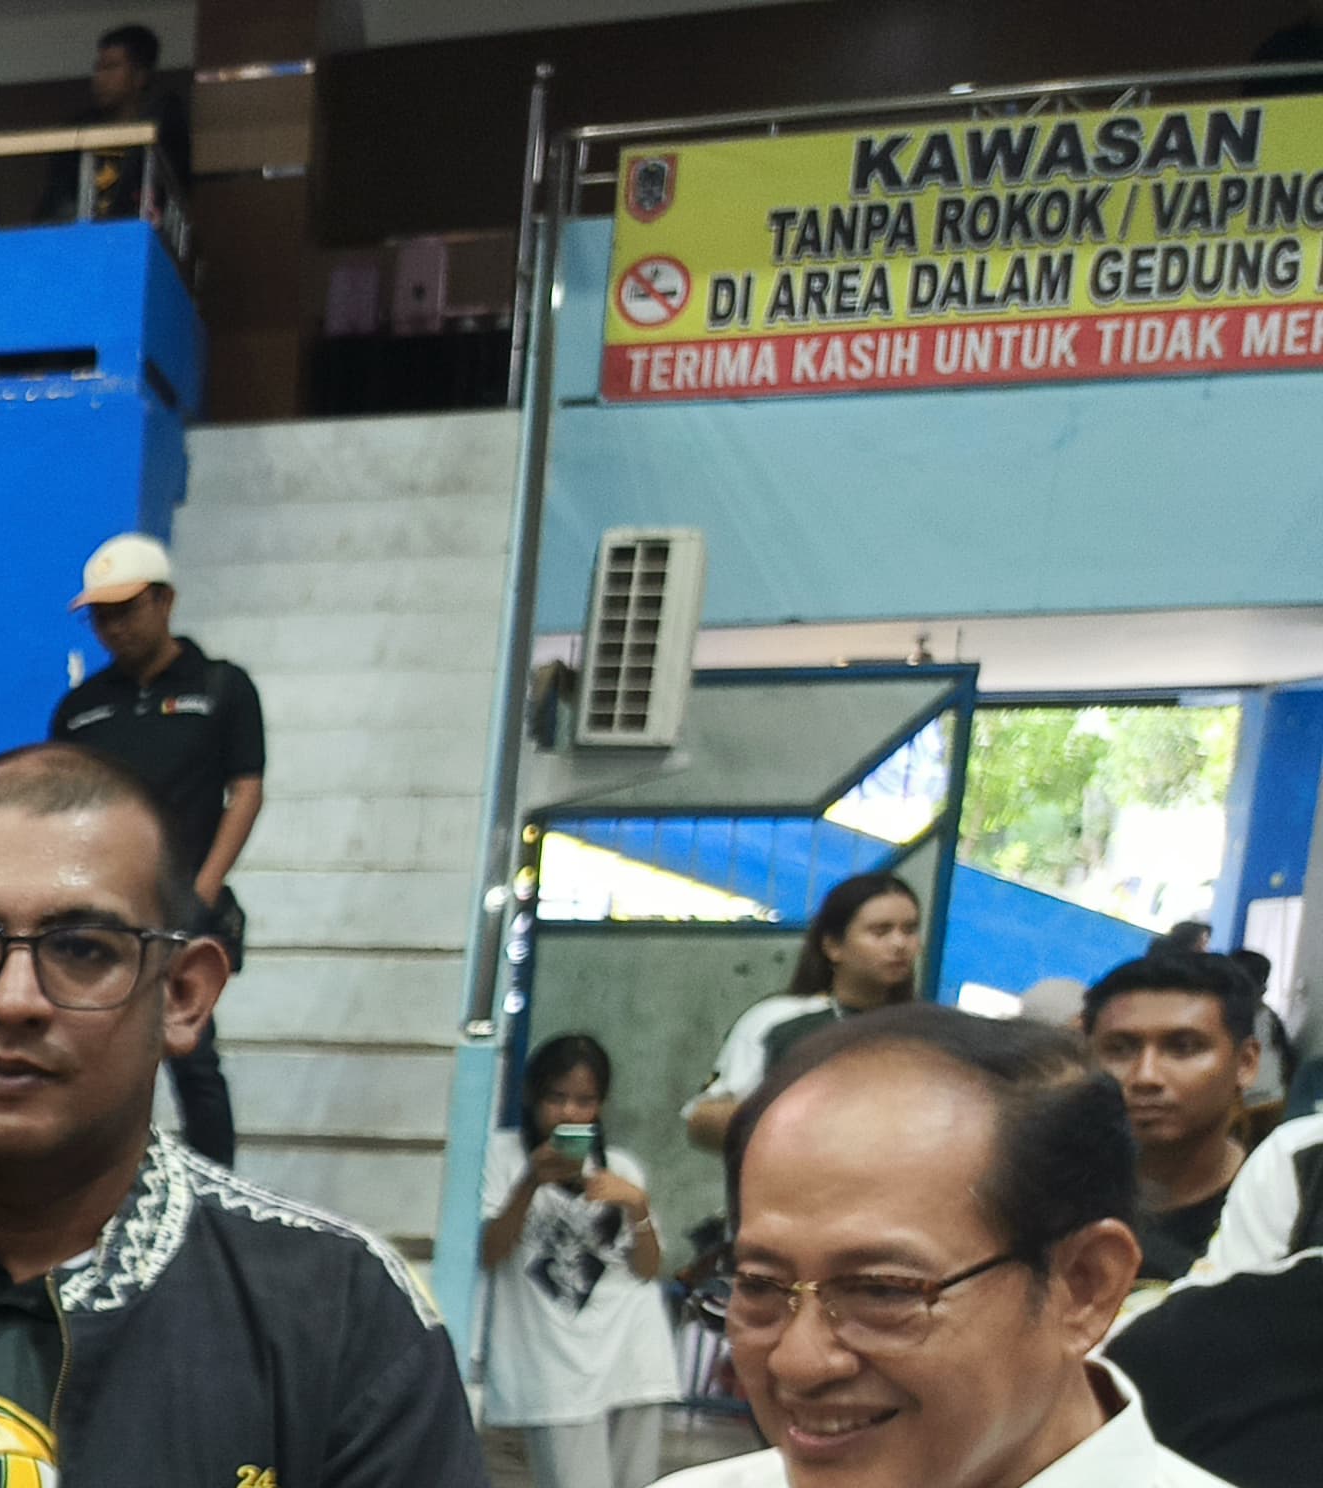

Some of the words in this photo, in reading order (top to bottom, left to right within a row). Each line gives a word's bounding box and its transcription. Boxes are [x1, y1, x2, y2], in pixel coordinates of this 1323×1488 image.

[852, 107, 1263, 197] KAWASAN
[767, 198, 919, 264] TANPA
[932, 182, 1109, 252] ROKOK
[1152, 170, 1323, 239] VAPING
[706, 272, 753, 332] DI
[763, 262, 892, 328] AREA
[906, 248, 1075, 317] DALAM
[1088, 235, 1303, 307] GEDUNG
[625, 340, 779, 393] TERIMA
[791, 329, 921, 385] KASIH
[933, 321, 1082, 377] UNTUK
[1096, 312, 1227, 367] TIDAK
